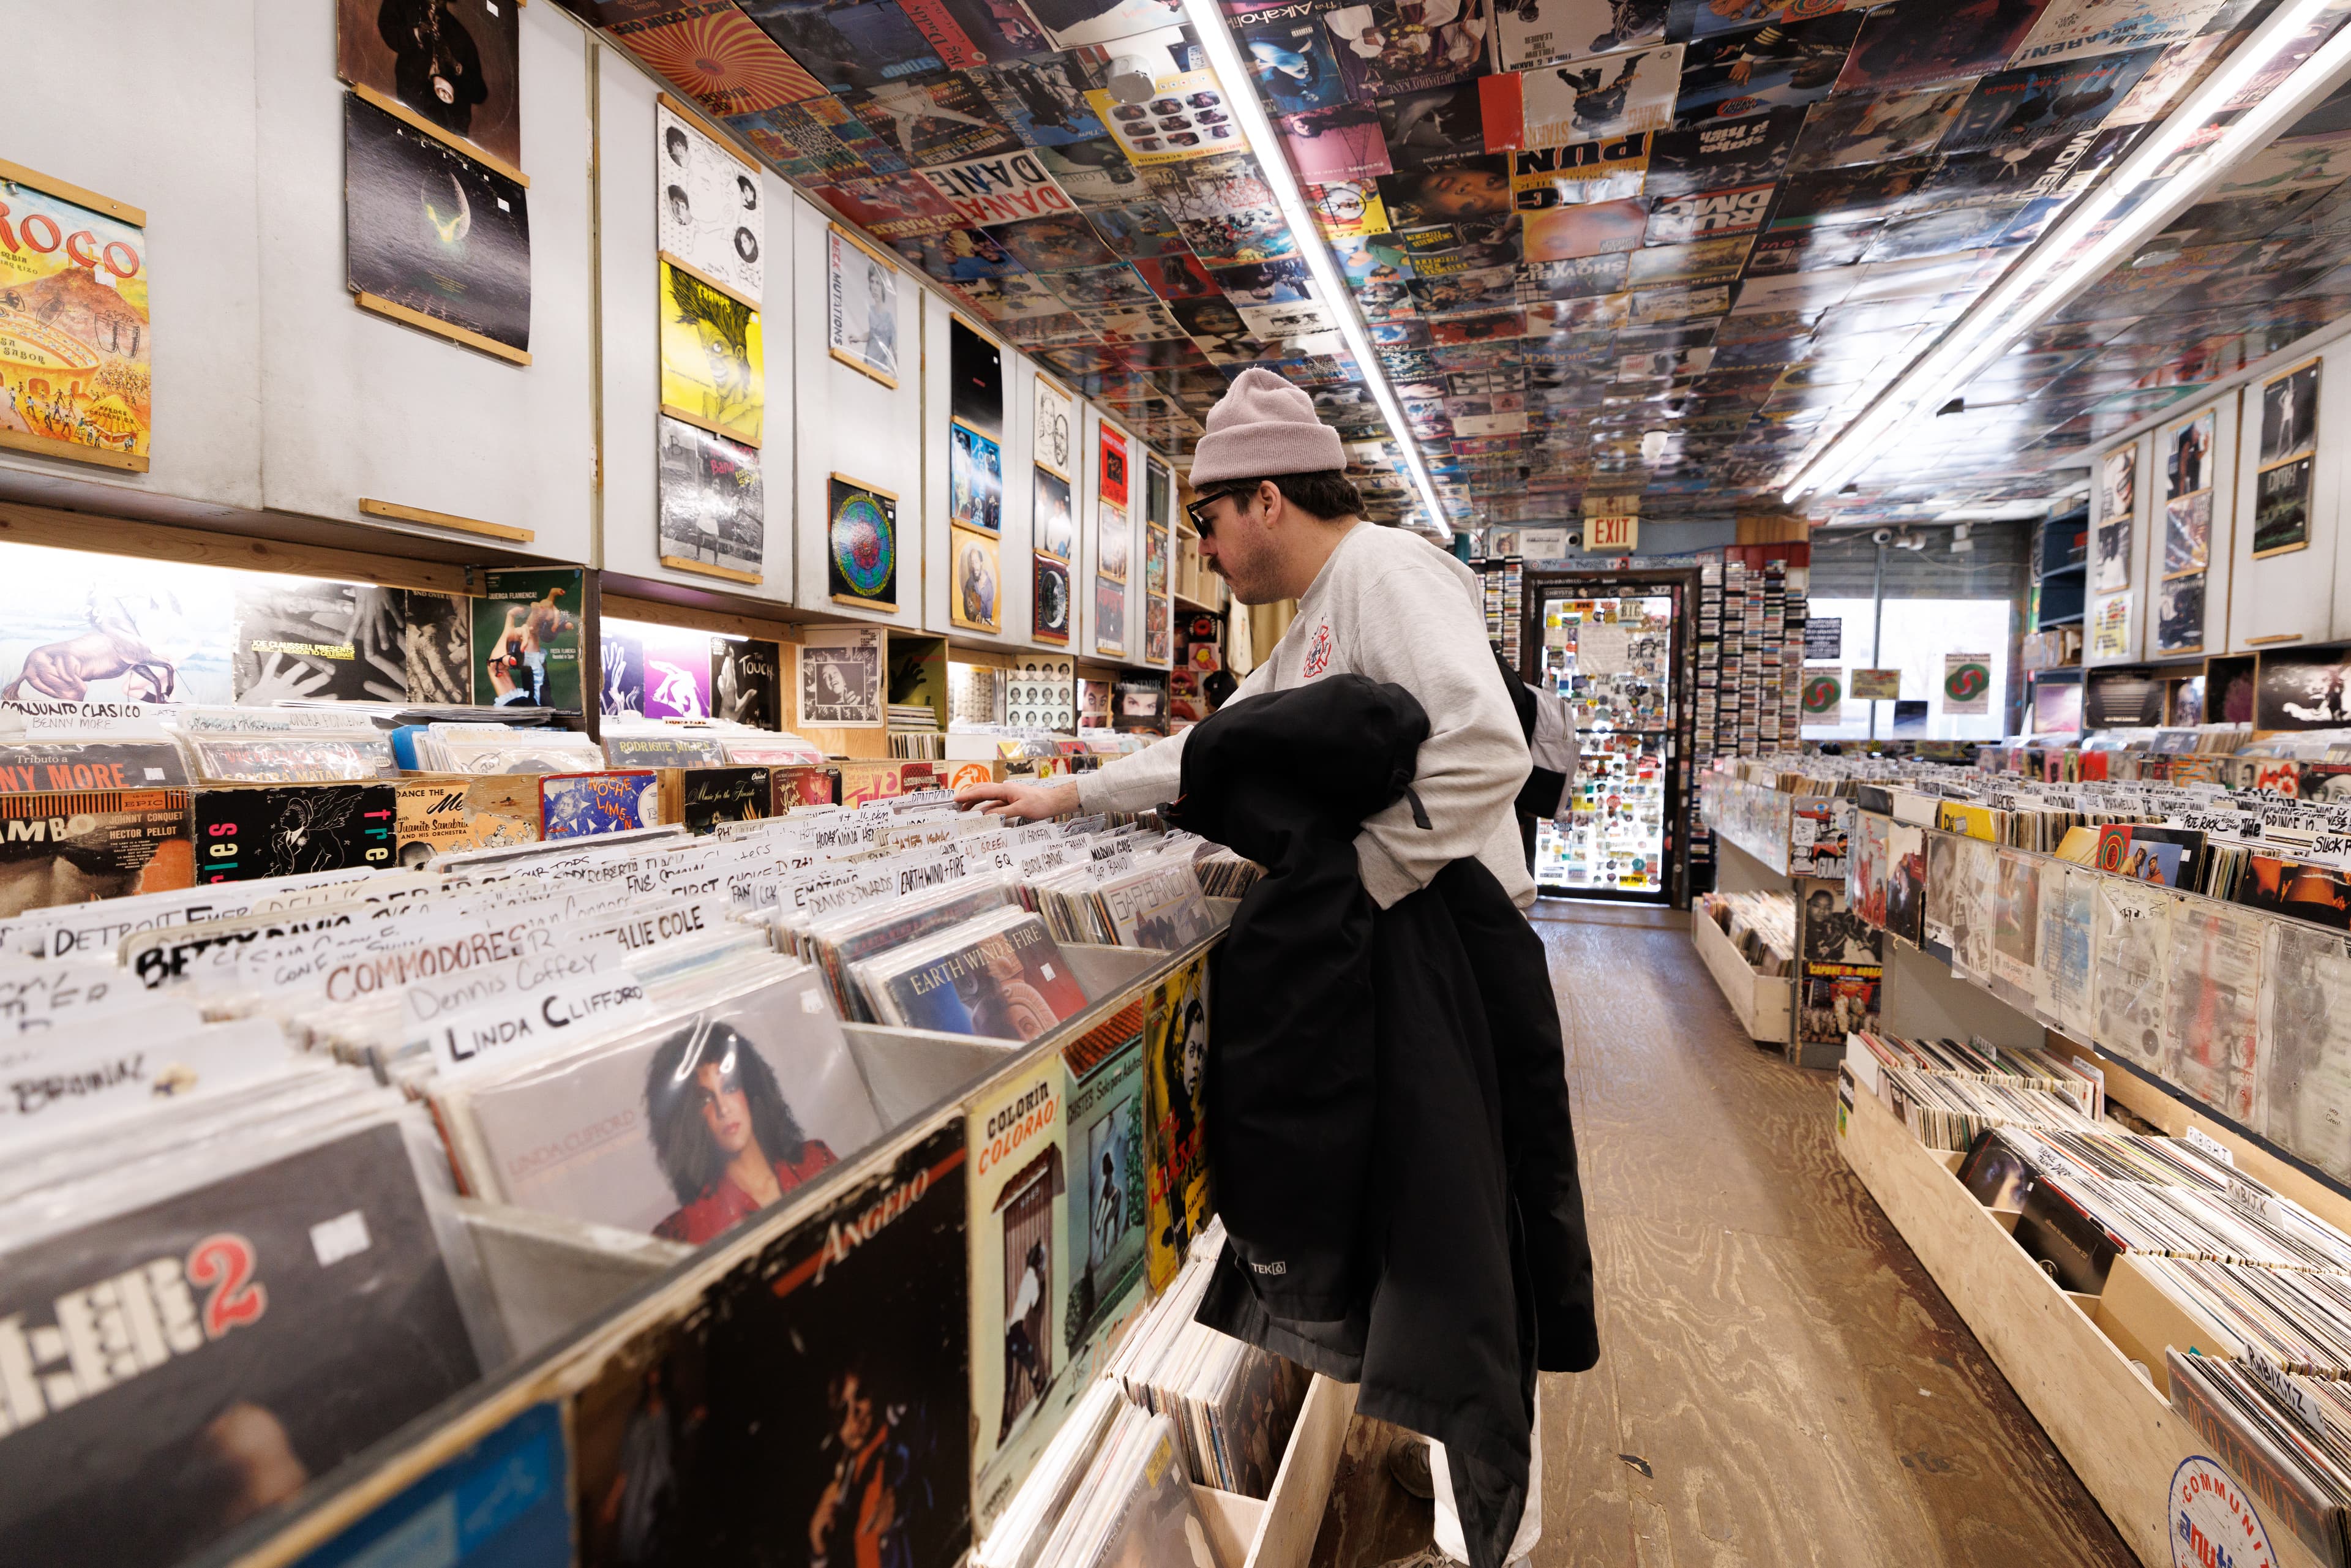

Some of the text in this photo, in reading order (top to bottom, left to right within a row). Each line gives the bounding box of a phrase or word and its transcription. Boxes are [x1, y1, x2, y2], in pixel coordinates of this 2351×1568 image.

[1524, 32, 1553, 44] LEADER
[1510, 60, 1533, 70] RAKIM
[1387, 79, 1411, 94] KANE
[1700, 124, 1747, 143] high
[1138, 154, 1182, 163] SCENARIO
[1513, 132, 1646, 175] PUN
[926, 155, 1046, 197] DANE
[954, 186, 1071, 222] DANA
[1655, 188, 1774, 216] DMC
[1654, 206, 1767, 234] RUN
[1515, 260, 1627, 282] SHOWBIZ
[698, 285, 730, 313] CRAMPS
[831, 236, 843, 346] BECK MUTATIONS
[3, 347, 46, 365] SABOR
[1595, 519, 1630, 544] EXIT
[268, 641, 313, 651] CLAUSSELL
[314, 645, 355, 654] PRESENTS
[753, 652, 763, 661] THE
[738, 655, 774, 681] TOUCH
[82, 703, 141, 718] CLASICO
[33, 718, 115, 729] BENNY MORE
[620, 741, 672, 753] RODRIGUE
[15, 755, 59, 763] Tributo
[47, 763, 130, 790] MORE
[588, 777, 632, 796] NOCHE
[685, 782, 714, 805] Music
[733, 781, 756, 803] Fireside
[2043, 795, 2075, 809] MADONNA
[0, 814, 96, 843] MBO
[110, 812, 183, 824] JOHNNY CONQUET
[398, 820, 430, 833] Juanito
[2202, 815, 2227, 833] ROCK
[110, 827, 177, 839] HECTOR PELLOT
[981, 836, 1008, 854] GREEN
[1065, 837, 1087, 851] GRAHAM
[1090, 845, 1115, 862] MARVIN
[950, 860, 966, 880] FIRE
[1093, 863, 1104, 882] GAP
[1107, 858, 1128, 876] BAND
[1111, 885, 1142, 921] GAP
[658, 906, 704, 939] COLE
[910, 958, 966, 996] EARTH
[963, 943, 1005, 971] WIND
[1012, 925, 1041, 950] FIRE
[408, 976, 508, 1022] Dennis
[446, 986, 642, 1062] LINDA CLIFFORD
[1123, 1056, 1143, 1081] Adultos
[978, 1093, 1060, 1175] COLORAO!
[813, 1168, 928, 1286] ANGELO
[1252, 1262, 1272, 1274] TEK
[187, 1234, 266, 1340] 2
